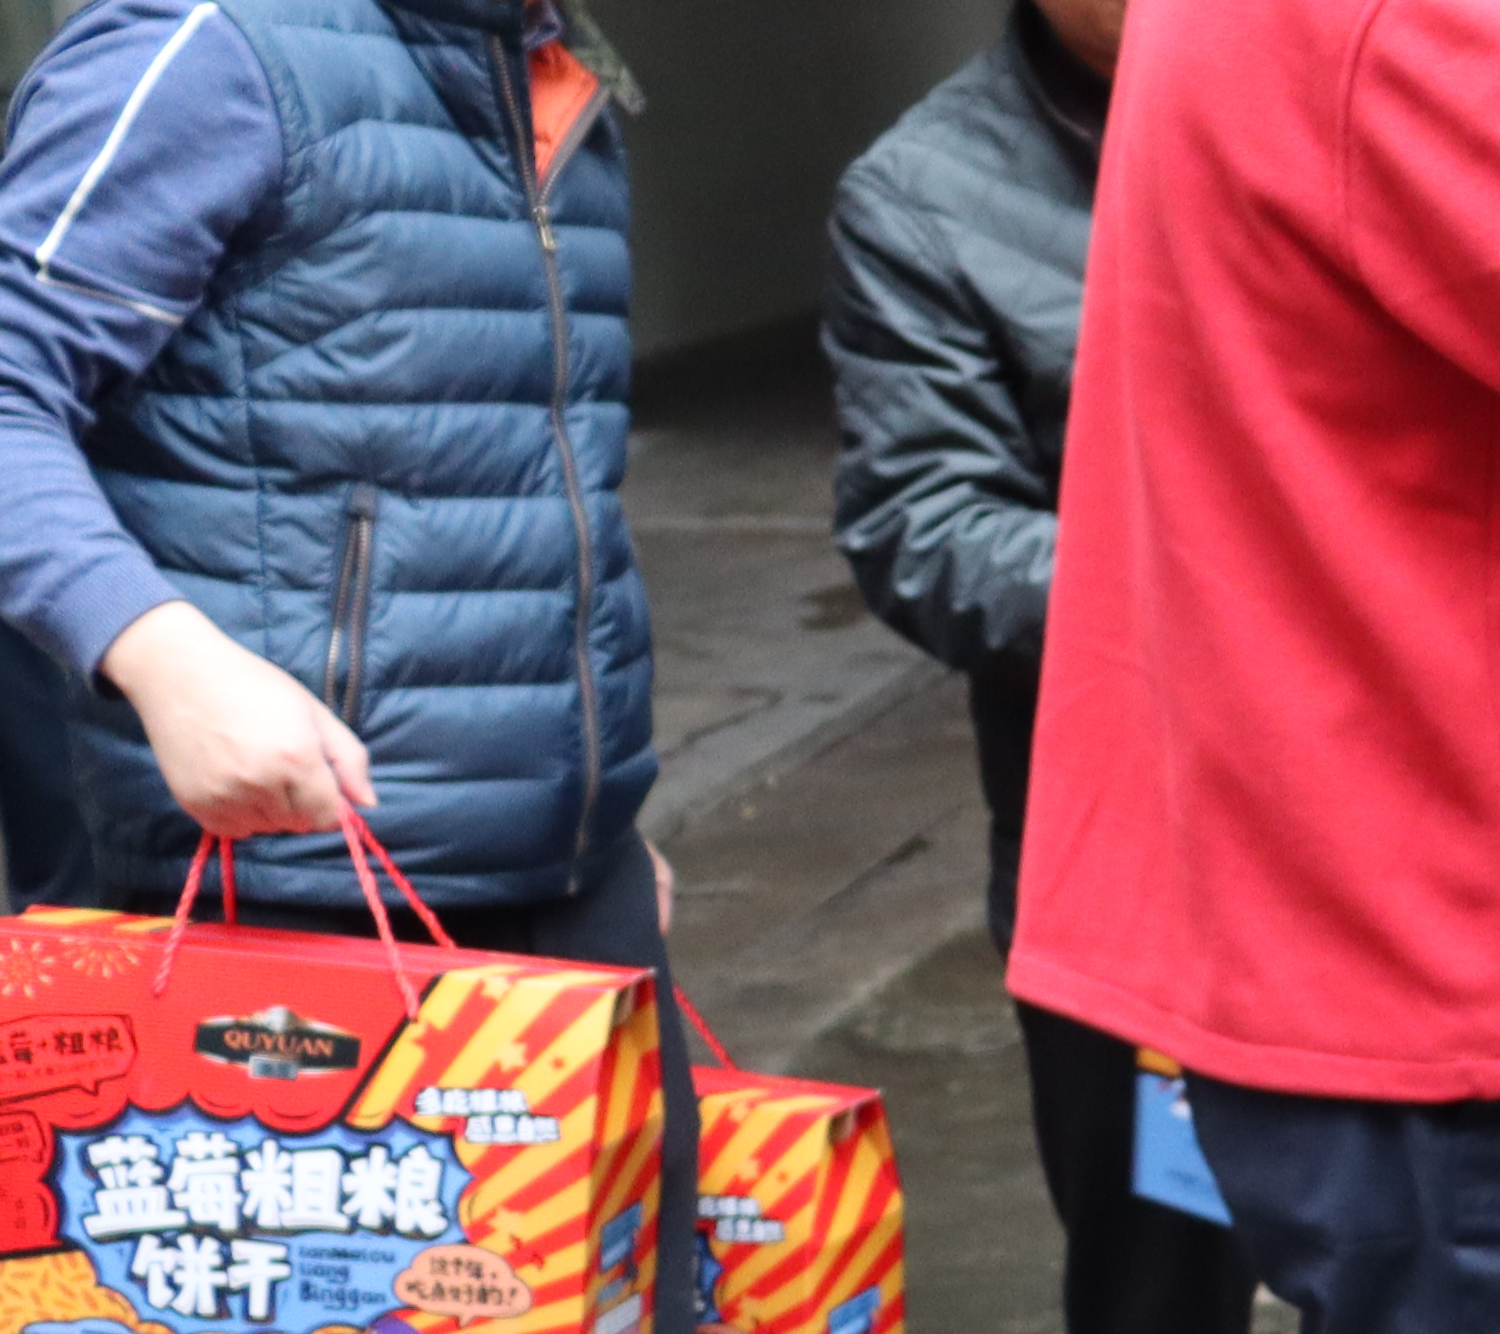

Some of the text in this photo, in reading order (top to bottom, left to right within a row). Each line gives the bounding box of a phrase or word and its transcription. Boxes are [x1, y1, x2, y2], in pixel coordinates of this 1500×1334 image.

[223, 1028, 335, 1058] QUYUAN
[82, 1130, 449, 1239] 蓝莓粗粮
[130, 1232, 291, 1319] 饼干
[300, 1264, 350, 1284] Liang
[300, 1280, 387, 1312] Binggan
